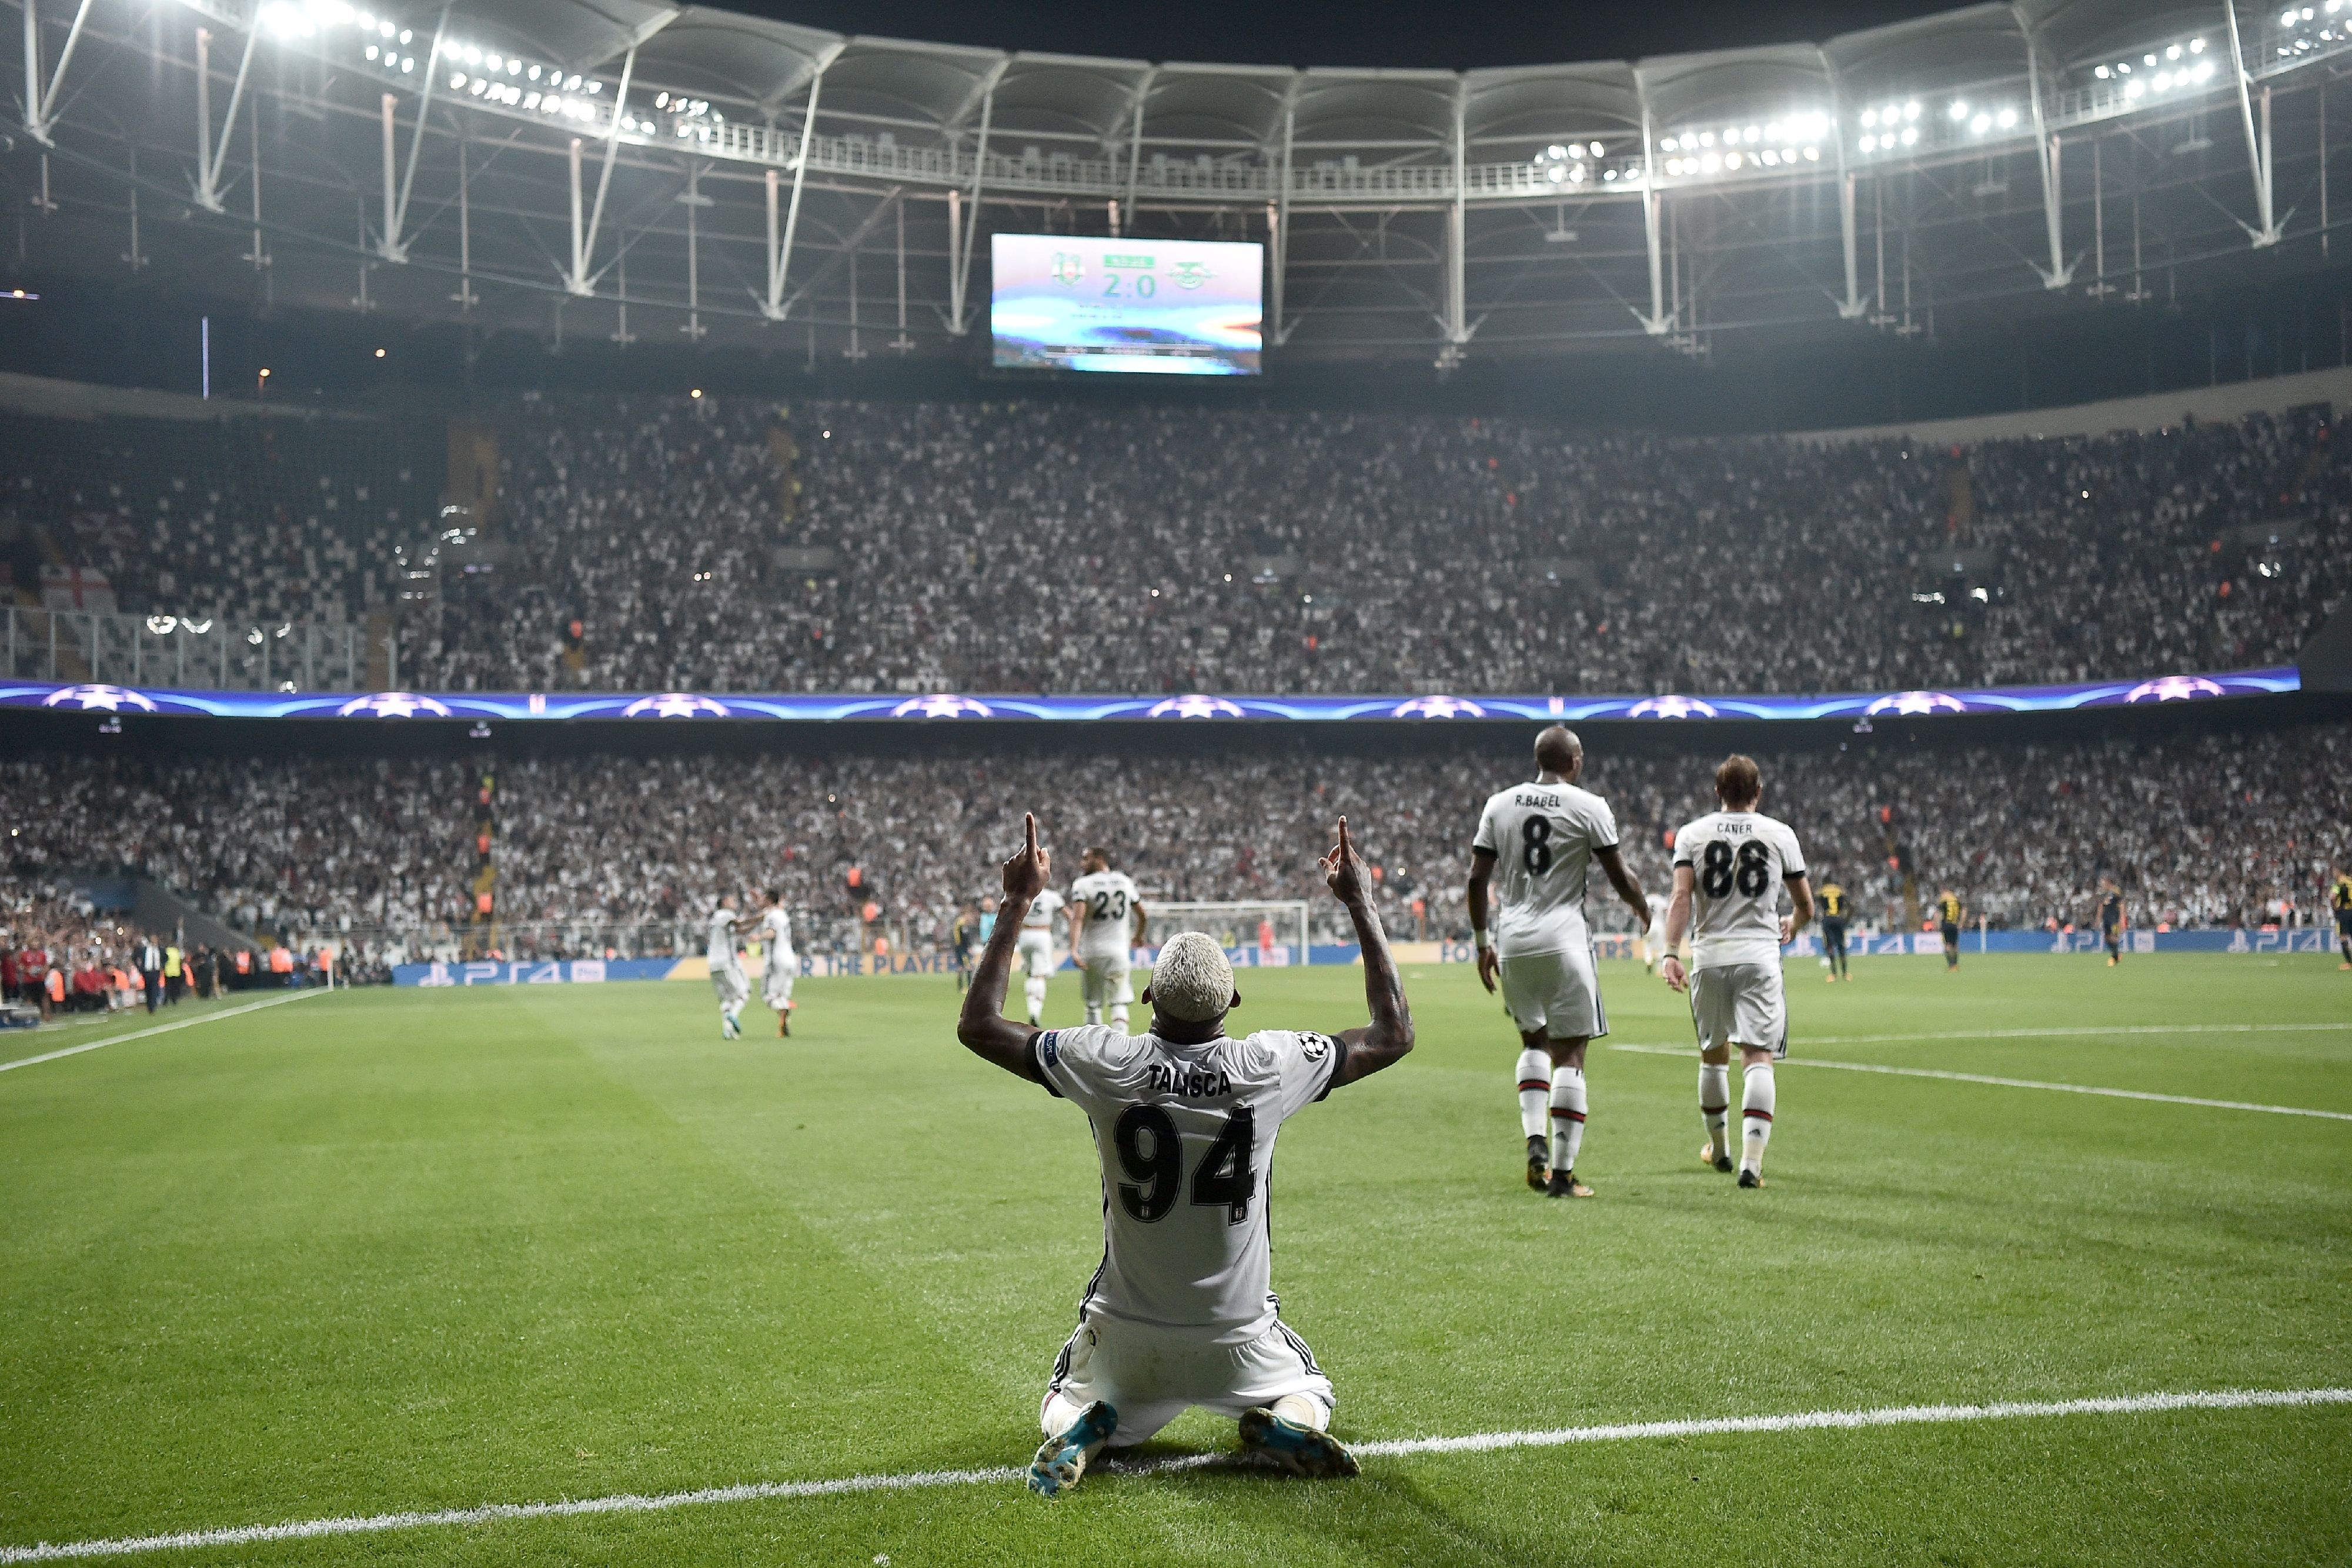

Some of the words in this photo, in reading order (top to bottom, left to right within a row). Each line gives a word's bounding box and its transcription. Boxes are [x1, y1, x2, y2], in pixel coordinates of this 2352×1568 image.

[1102, 273, 1156, 299] 2:0
[1515, 795, 1561, 807] R.BABEL
[1717, 823, 1752, 835] CANER
[1522, 815, 1552, 875] 8
[1703, 840, 1769, 898] 88
[1093, 890, 1125, 921] 23
[2256, 930, 2322, 953] PS4
[463, 961, 563, 986] PS4
[824, 954, 862, 976] THE
[873, 954, 974, 974] PLAYER
[1148, 1064, 1232, 1098] TALISCA
[1115, 1103, 1257, 1226] 94
